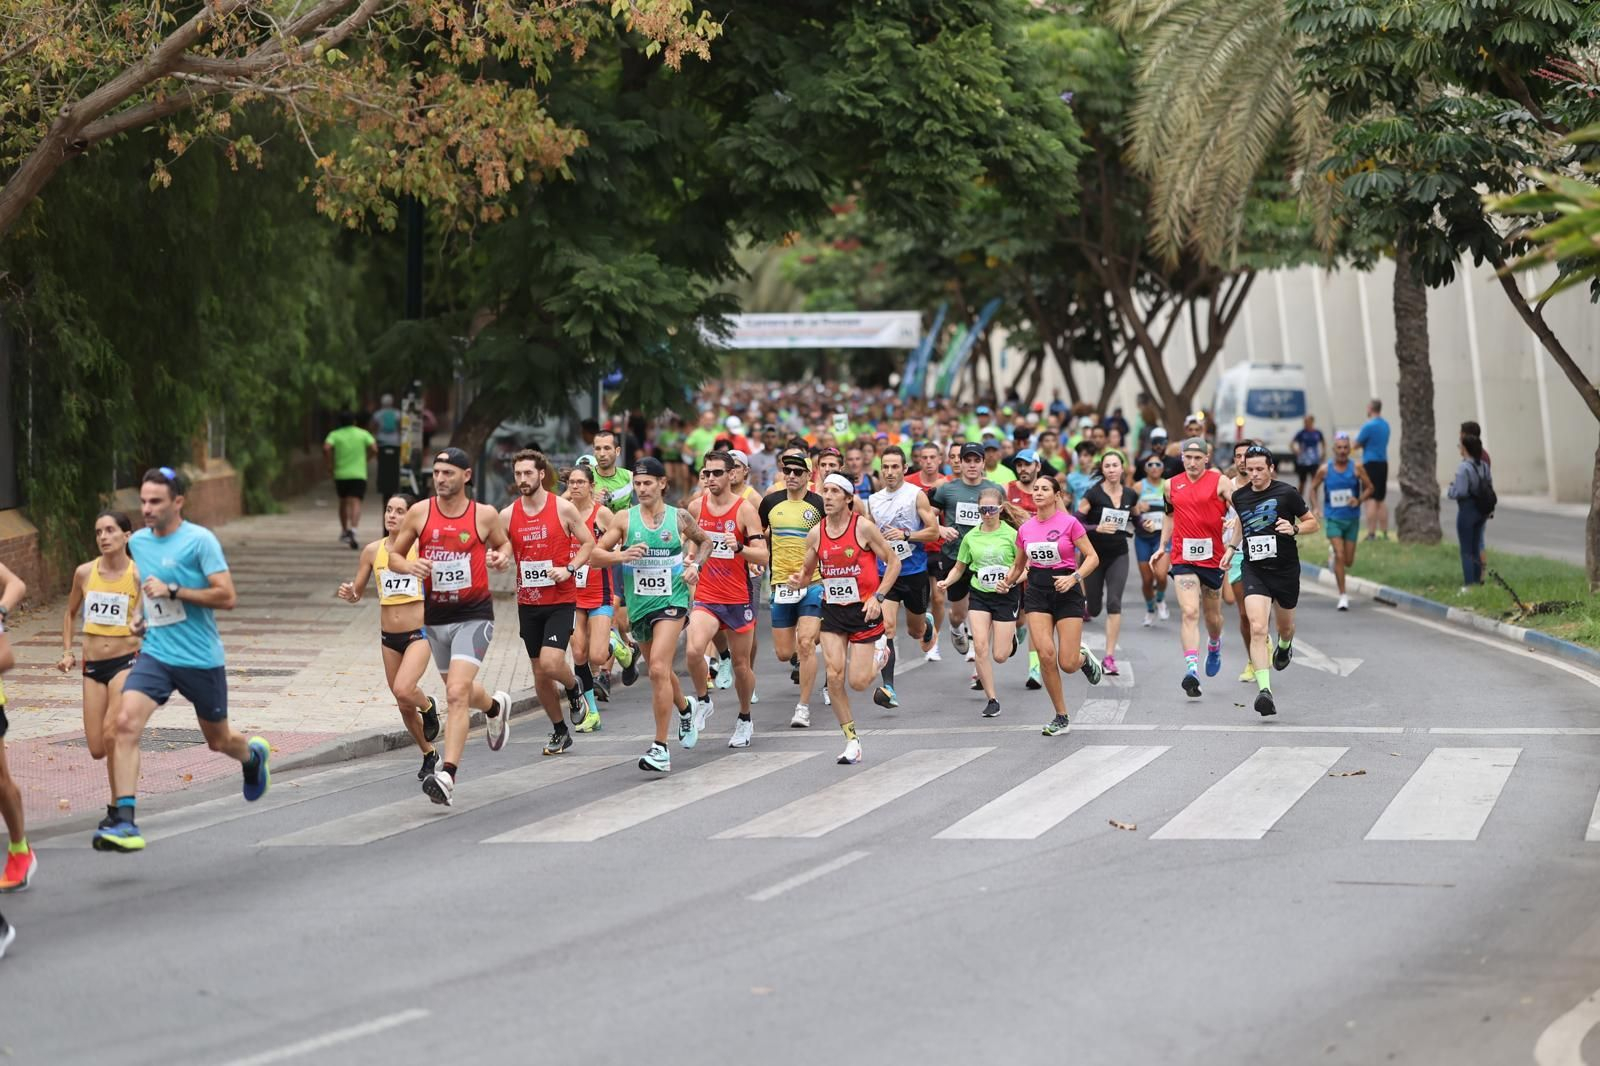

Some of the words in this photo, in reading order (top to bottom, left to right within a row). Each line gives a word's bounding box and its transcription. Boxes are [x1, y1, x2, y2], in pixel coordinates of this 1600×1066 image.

[960, 511, 980, 519] 305
[712, 541, 728, 550] 73
[1250, 544, 1270, 553] 931
[1031, 550, 1054, 559] 538
[436, 570, 464, 581] 732
[525, 570, 547, 579] 894
[982, 573, 1005, 582] 478
[386, 578, 410, 588] 477
[639, 578, 665, 587] 403
[829, 586, 853, 595] 624
[91, 602, 120, 615] 476
